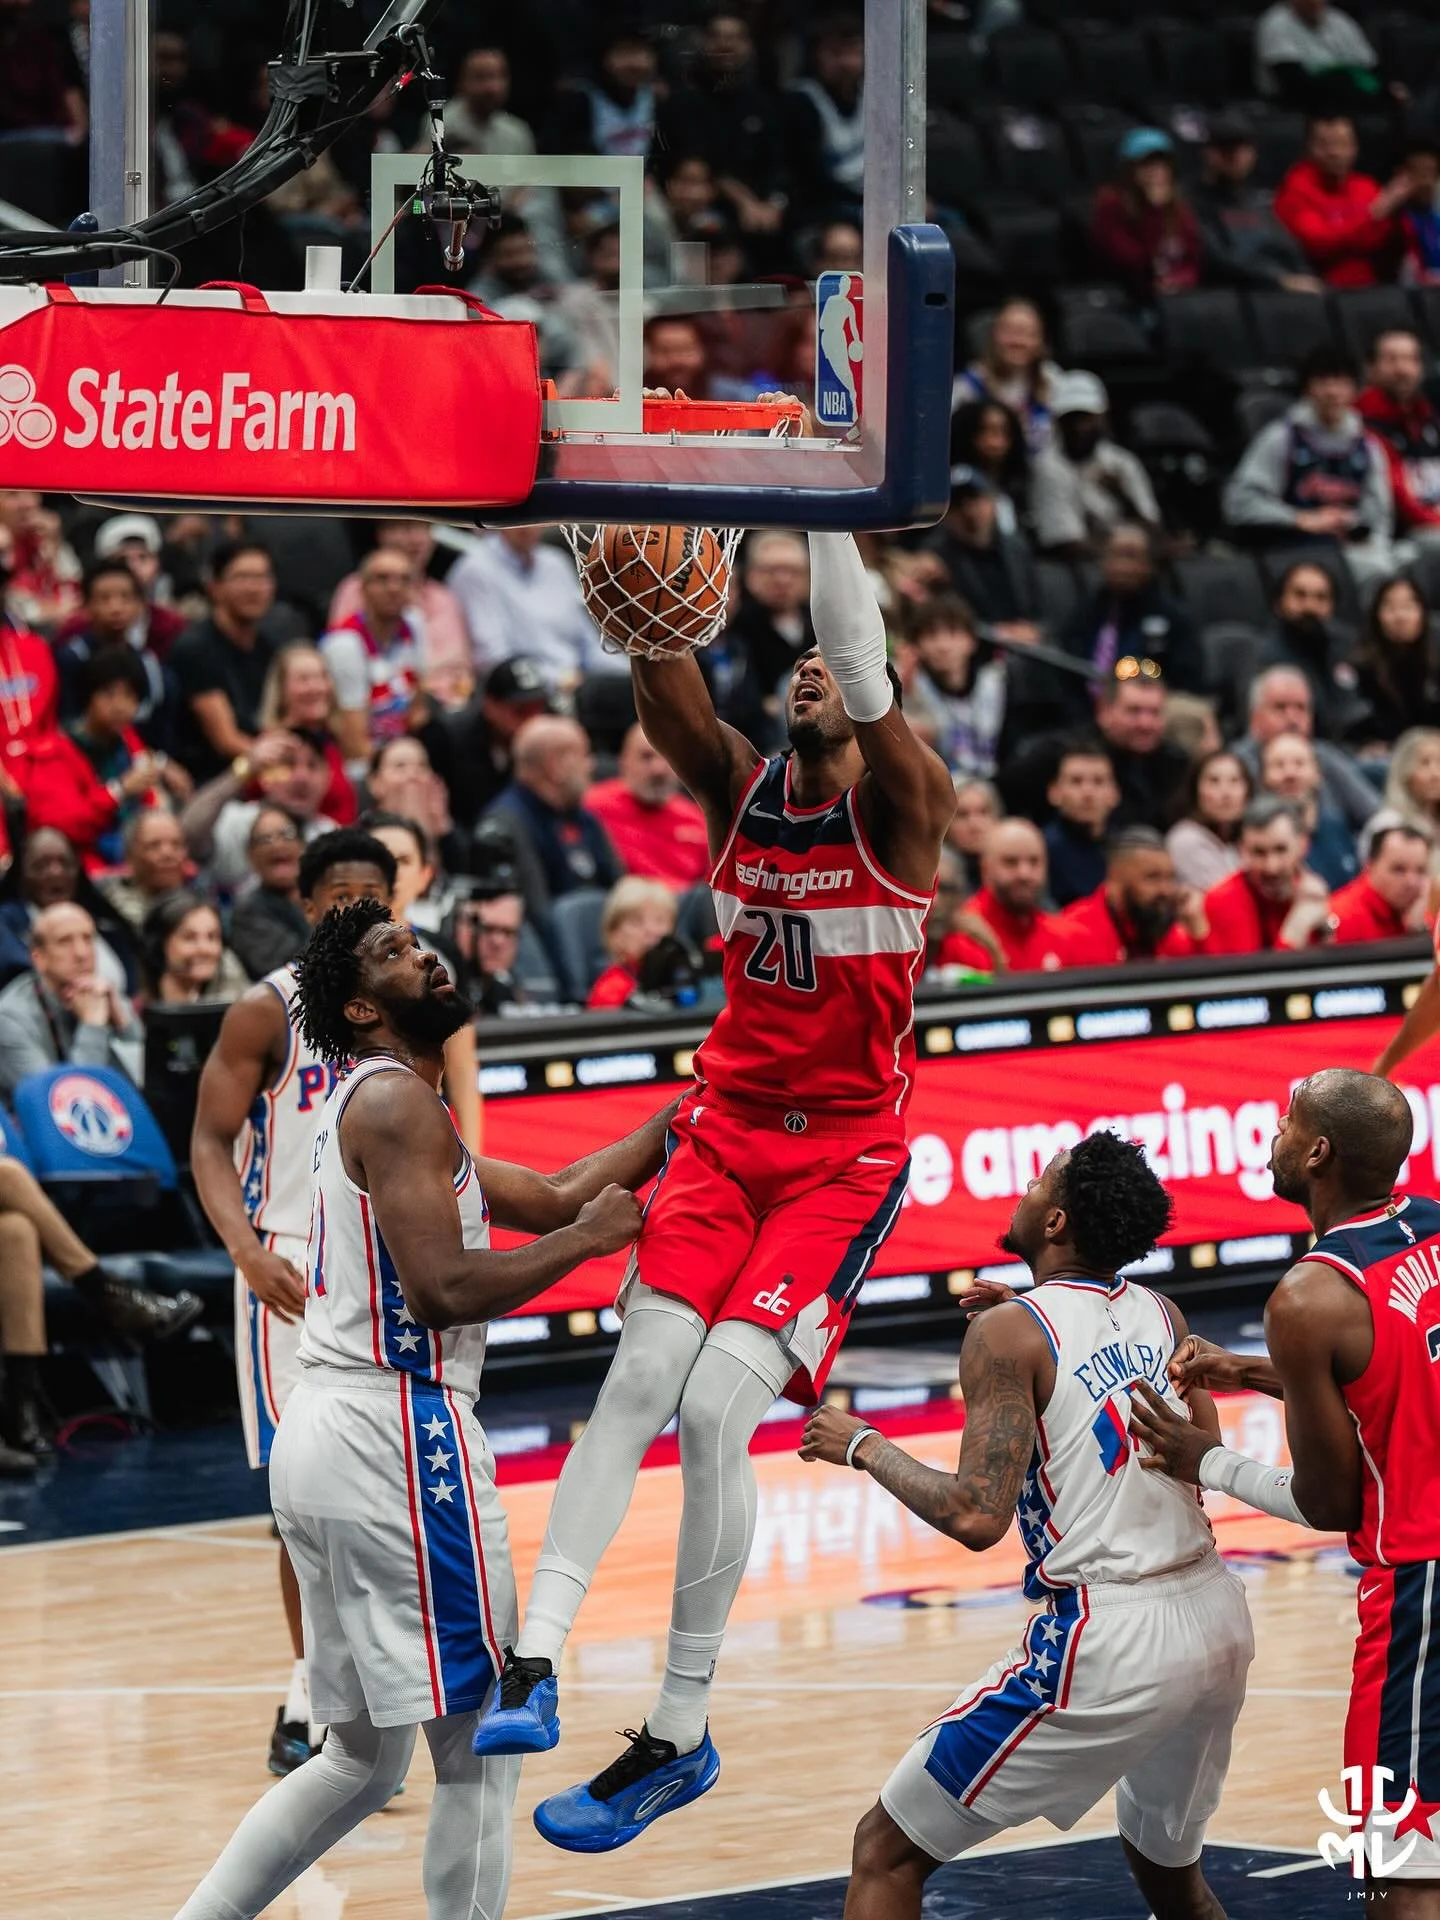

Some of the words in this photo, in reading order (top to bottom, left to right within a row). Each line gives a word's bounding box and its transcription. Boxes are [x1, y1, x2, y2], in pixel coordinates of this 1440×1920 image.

[823, 391, 847, 415] NBA
[735, 858, 854, 900] ashington
[744, 910, 817, 993] 20
[752, 1276, 792, 1316] dc
